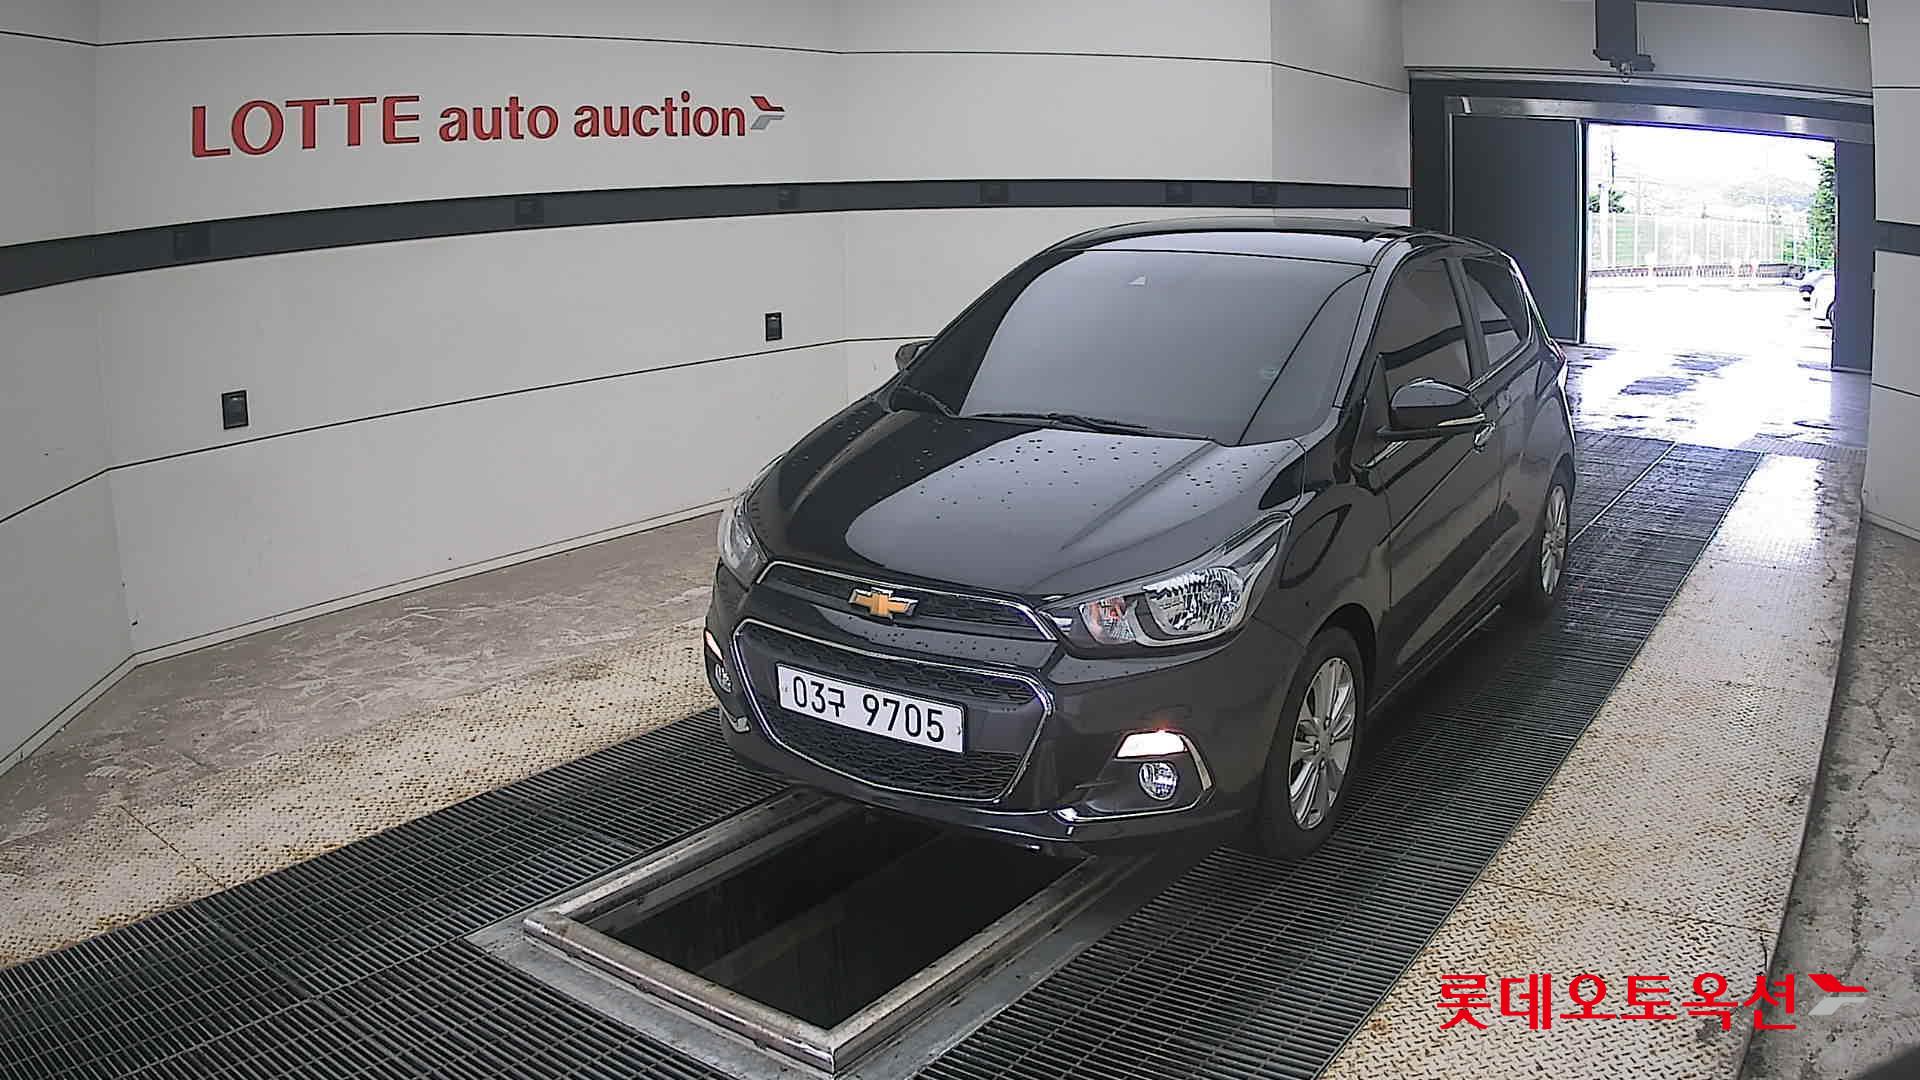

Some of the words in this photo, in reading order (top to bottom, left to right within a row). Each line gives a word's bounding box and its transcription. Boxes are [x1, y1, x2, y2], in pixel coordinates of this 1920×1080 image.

[192, 95, 420, 158] LOTTE
[438, 96, 559, 142] auto
[574, 90, 746, 137] auction
[792, 676, 846, 718] 03구
[862, 693, 945, 743] 9705
